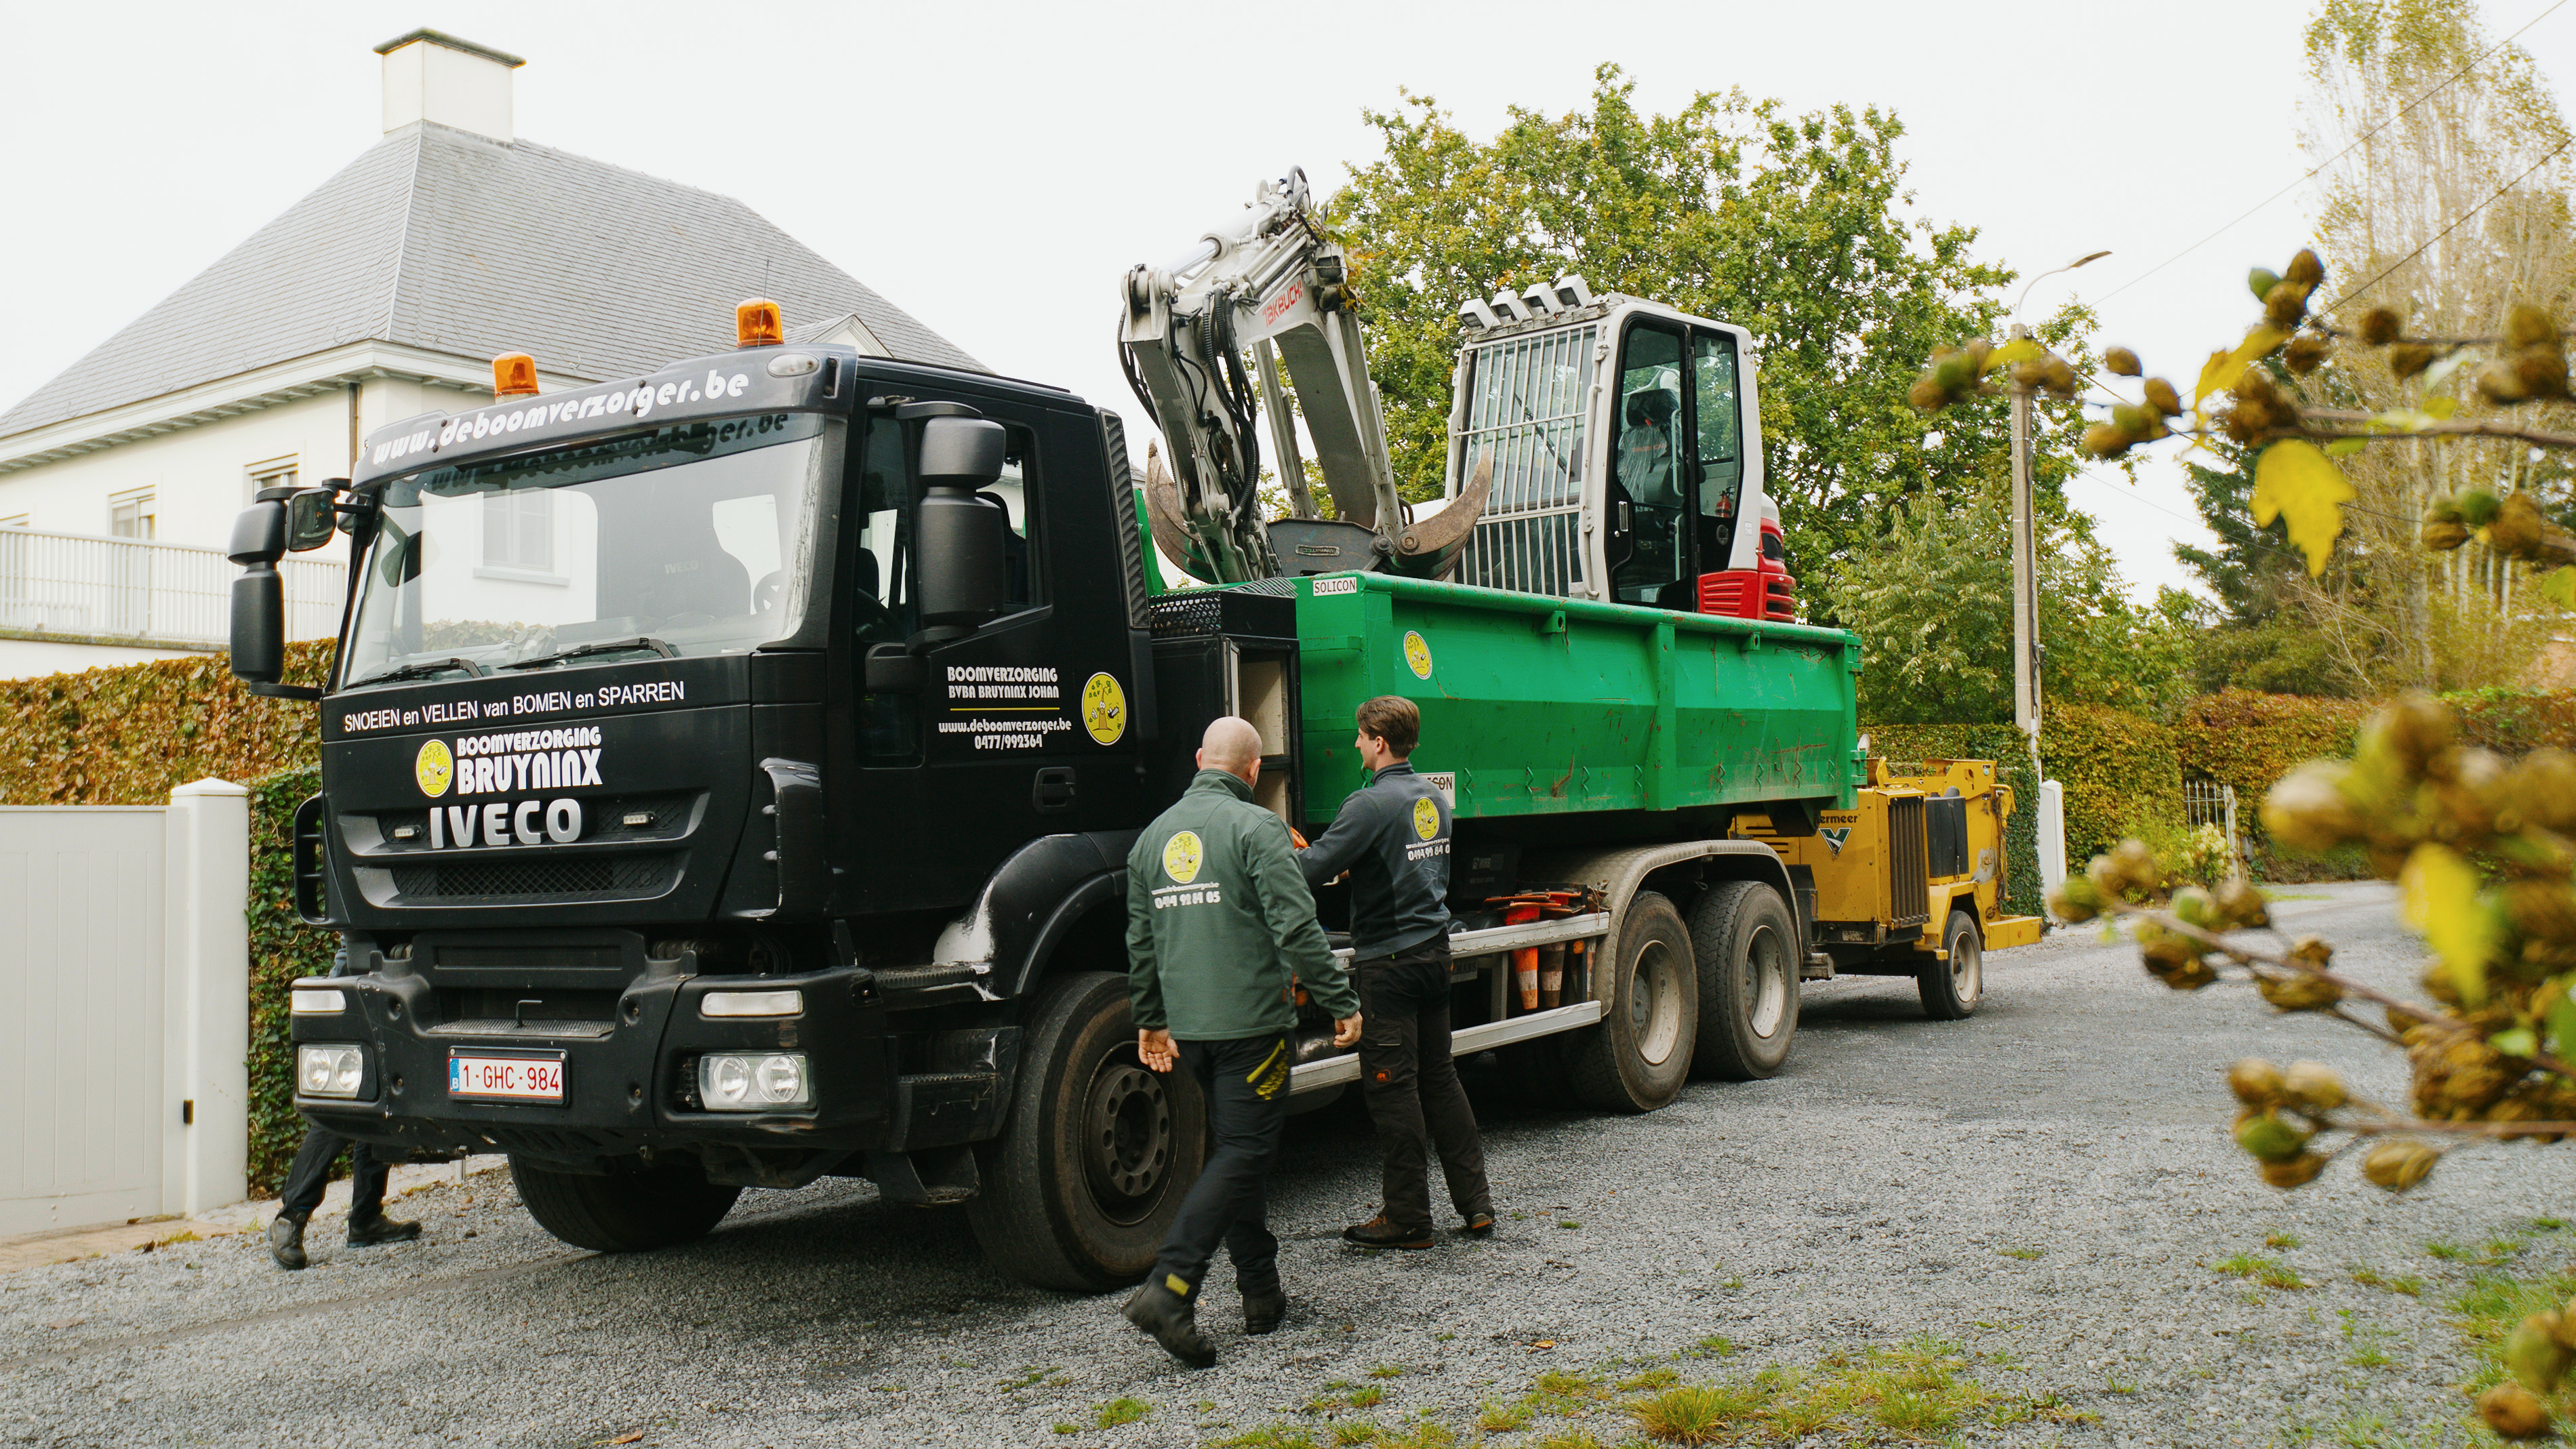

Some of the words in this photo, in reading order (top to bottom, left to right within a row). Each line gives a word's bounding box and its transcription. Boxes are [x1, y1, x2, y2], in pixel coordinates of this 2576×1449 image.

[373, 369, 749, 465] www.deboomverzorger.be
[1314, 579, 1355, 593] SOLICON
[946, 666, 1058, 682] BOOMVERZORGING
[948, 685, 976, 699] BVBA
[978, 685, 1027, 699] BRUYNINX
[1028, 685, 1060, 699] JOHAN
[344, 708, 401, 733] SNOEIEN
[403, 712, 420, 726] en
[422, 700, 479, 724] VELLEN
[483, 701, 508, 718] van
[513, 691, 571, 715] BOMEN
[575, 692, 595, 709] en
[598, 680, 685, 707] SPARREN
[938, 717, 1072, 735] www.deboomverzorger.be
[457, 726, 602, 757] BOOMVERZORGING
[974, 734, 1043, 751] 0477/992364
[457, 748, 603, 795] BRUYNINX
[430, 798, 582, 849] IVECO
[1205, 891, 1221, 903] 05
[451, 1077, 460, 1089] B
[463, 1064, 559, 1091] 1-GHC-984
